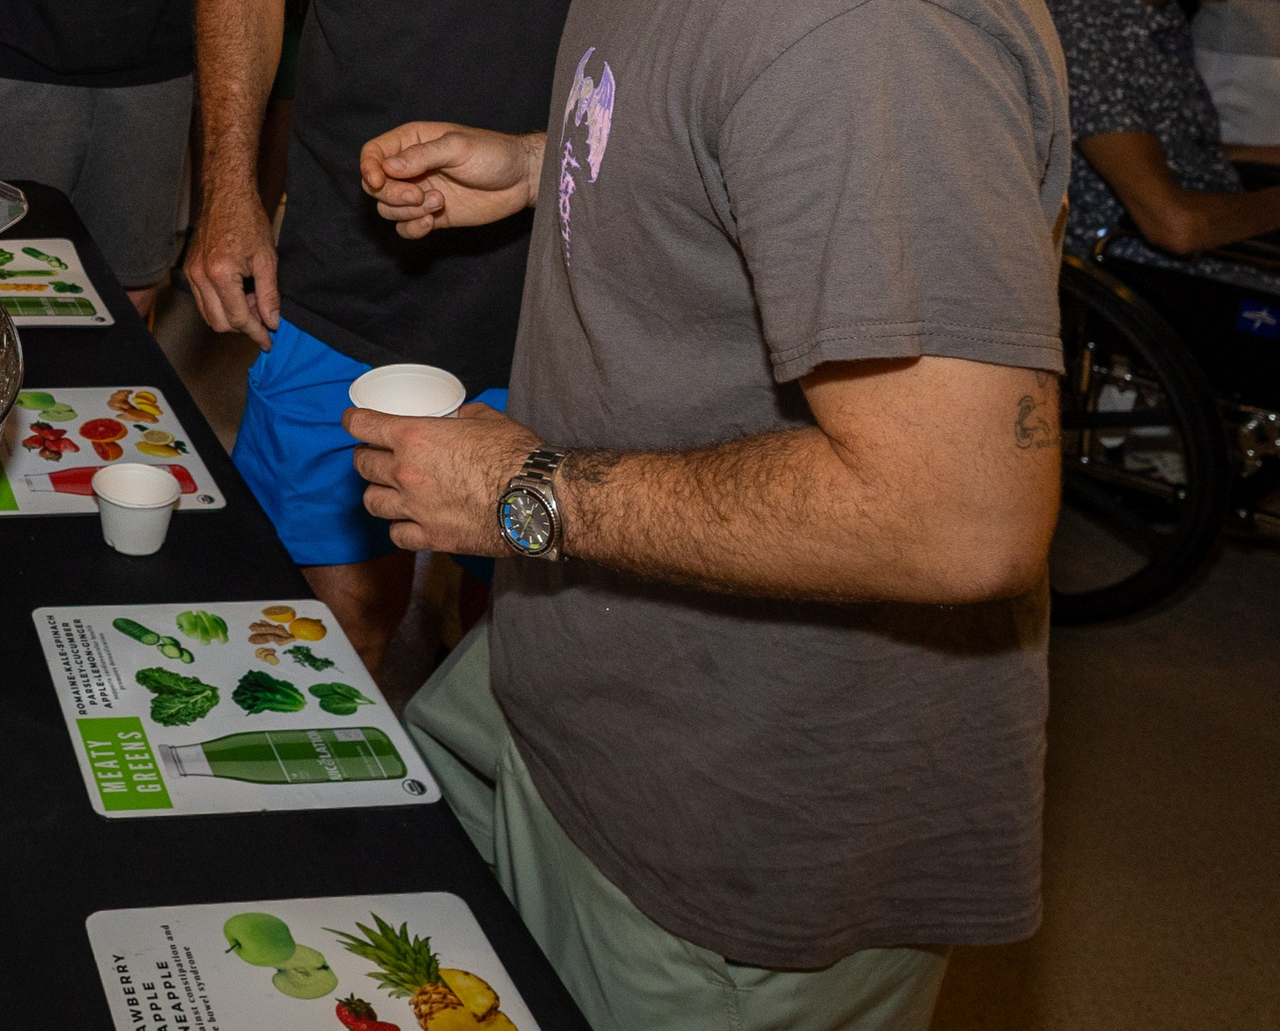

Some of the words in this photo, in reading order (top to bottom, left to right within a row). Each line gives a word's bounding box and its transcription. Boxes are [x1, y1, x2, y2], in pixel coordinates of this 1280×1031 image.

[86, 740, 128, 793] MEATY
[117, 731, 162, 793] GREENS
[161, 924, 174, 941] and
[170, 944, 196, 1004] constipation
[183, 946, 206, 992] syndrome
[142, 981, 168, 1031] APPLE
[199, 995, 216, 1023] bowel
